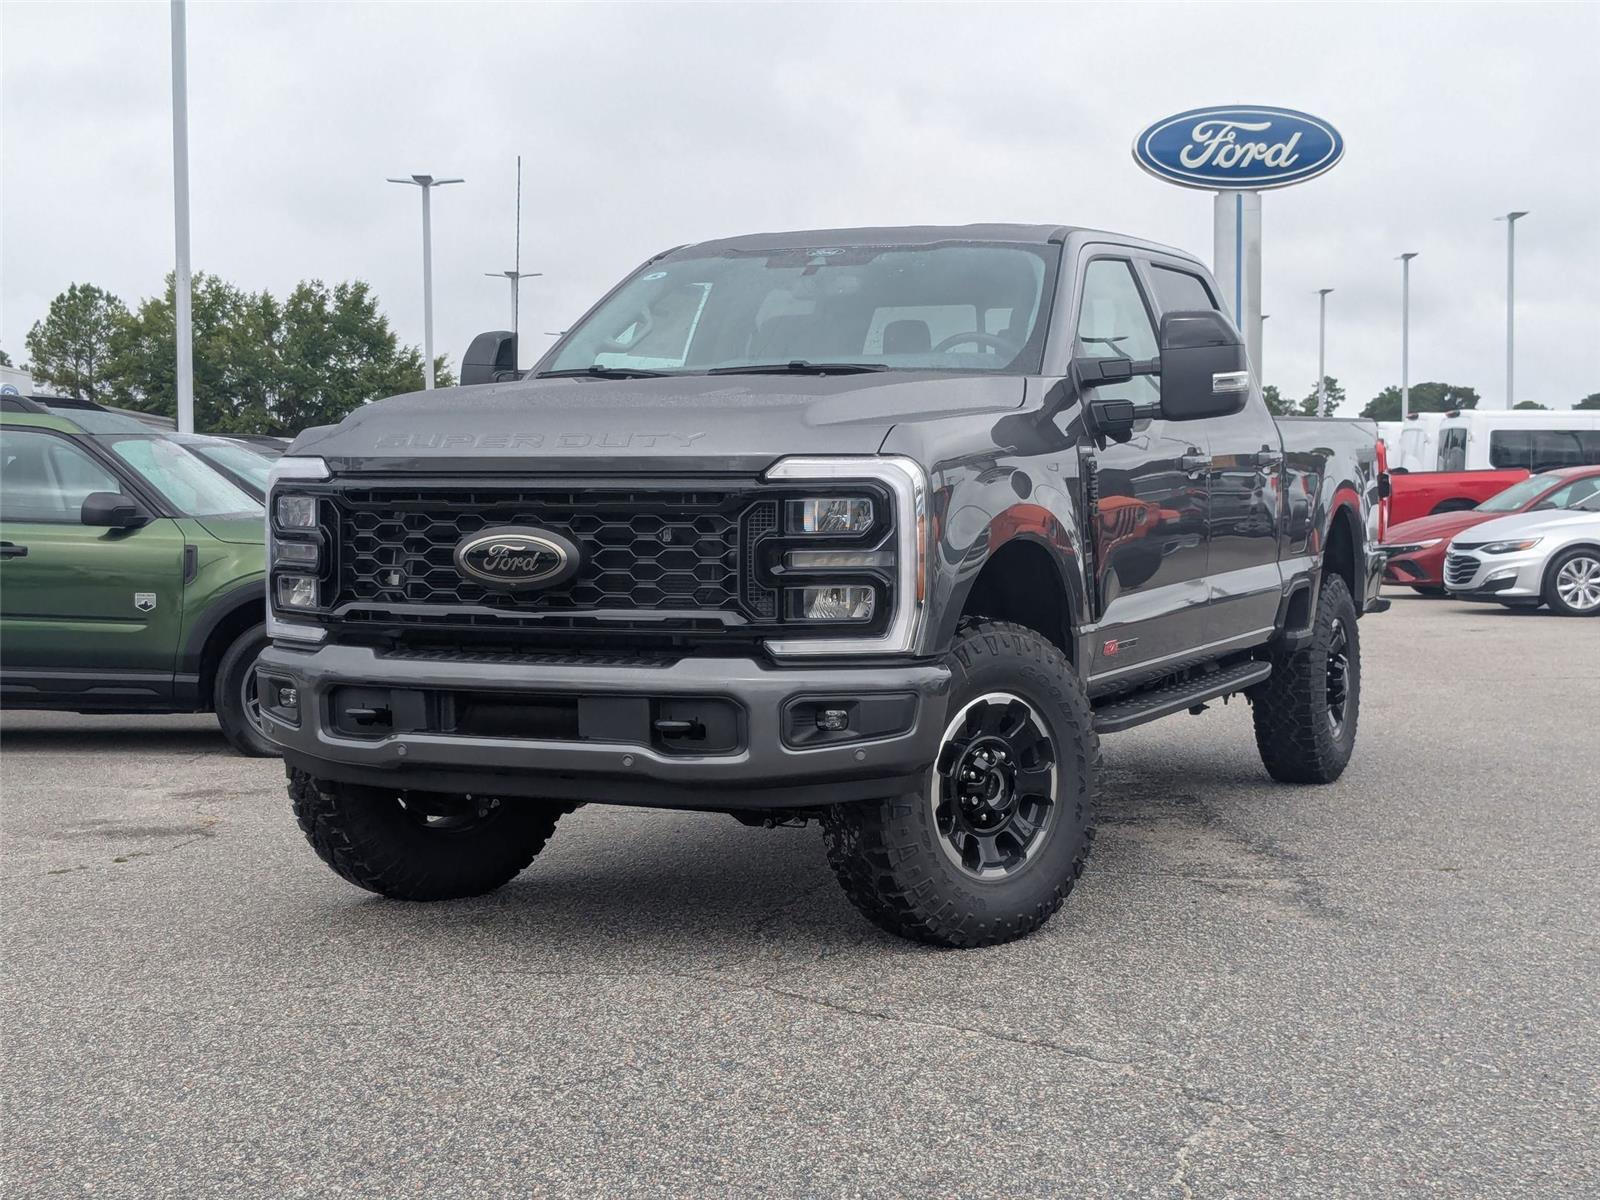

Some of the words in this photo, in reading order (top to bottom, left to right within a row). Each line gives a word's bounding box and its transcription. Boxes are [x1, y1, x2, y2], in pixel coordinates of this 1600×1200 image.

[1181, 120, 1302, 168] Ford
[375, 432, 545, 448] SUPER
[557, 431, 707, 448] DUTY
[483, 544, 541, 571] Ford
